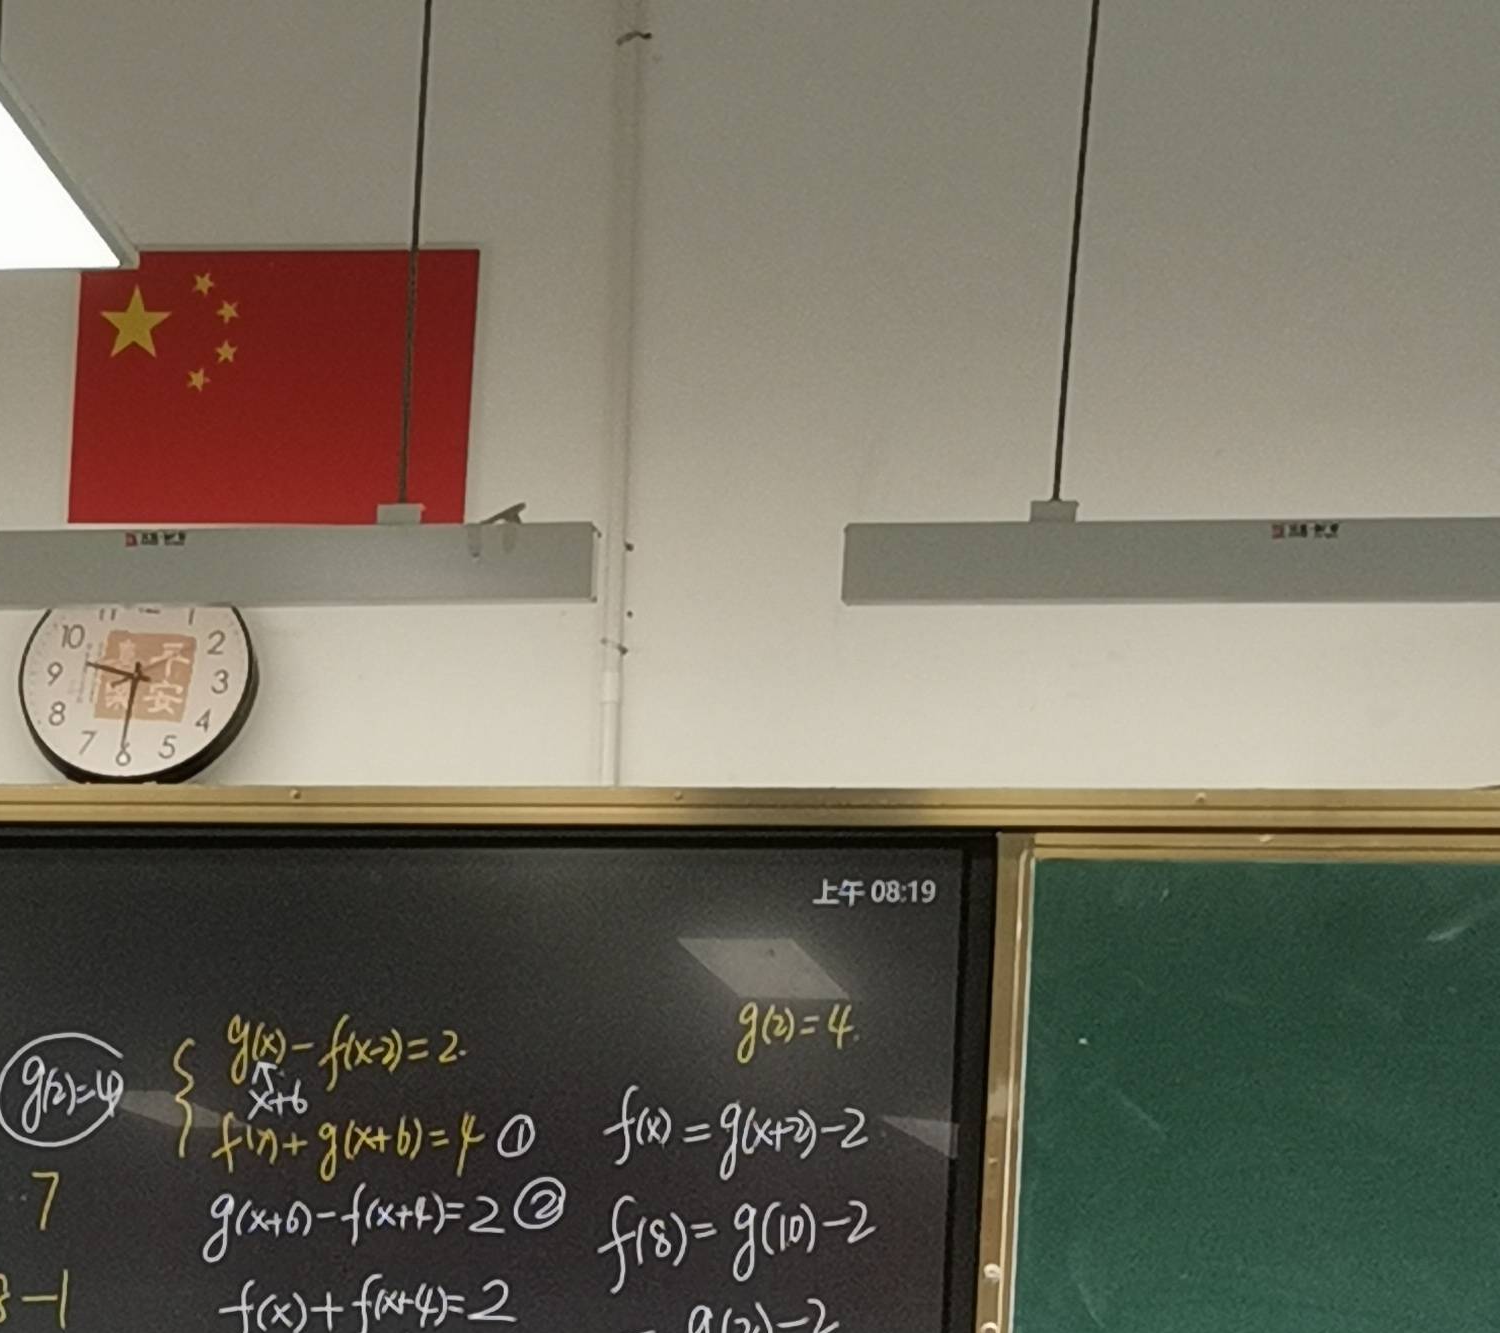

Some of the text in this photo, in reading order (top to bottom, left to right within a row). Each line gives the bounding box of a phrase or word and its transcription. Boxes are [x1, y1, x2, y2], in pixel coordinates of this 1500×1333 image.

[62, 624, 85, 649] 10
[207, 630, 226, 655] 2
[47, 662, 63, 685] 9
[210, 669, 229, 694] 3
[49, 701, 66, 726] 8
[195, 708, 211, 733] 4
[79, 730, 97, 755] 7
[115, 742, 131, 766] 6
[158, 735, 178, 759] 5
[813, 880, 937, 906] 上午 08:19
